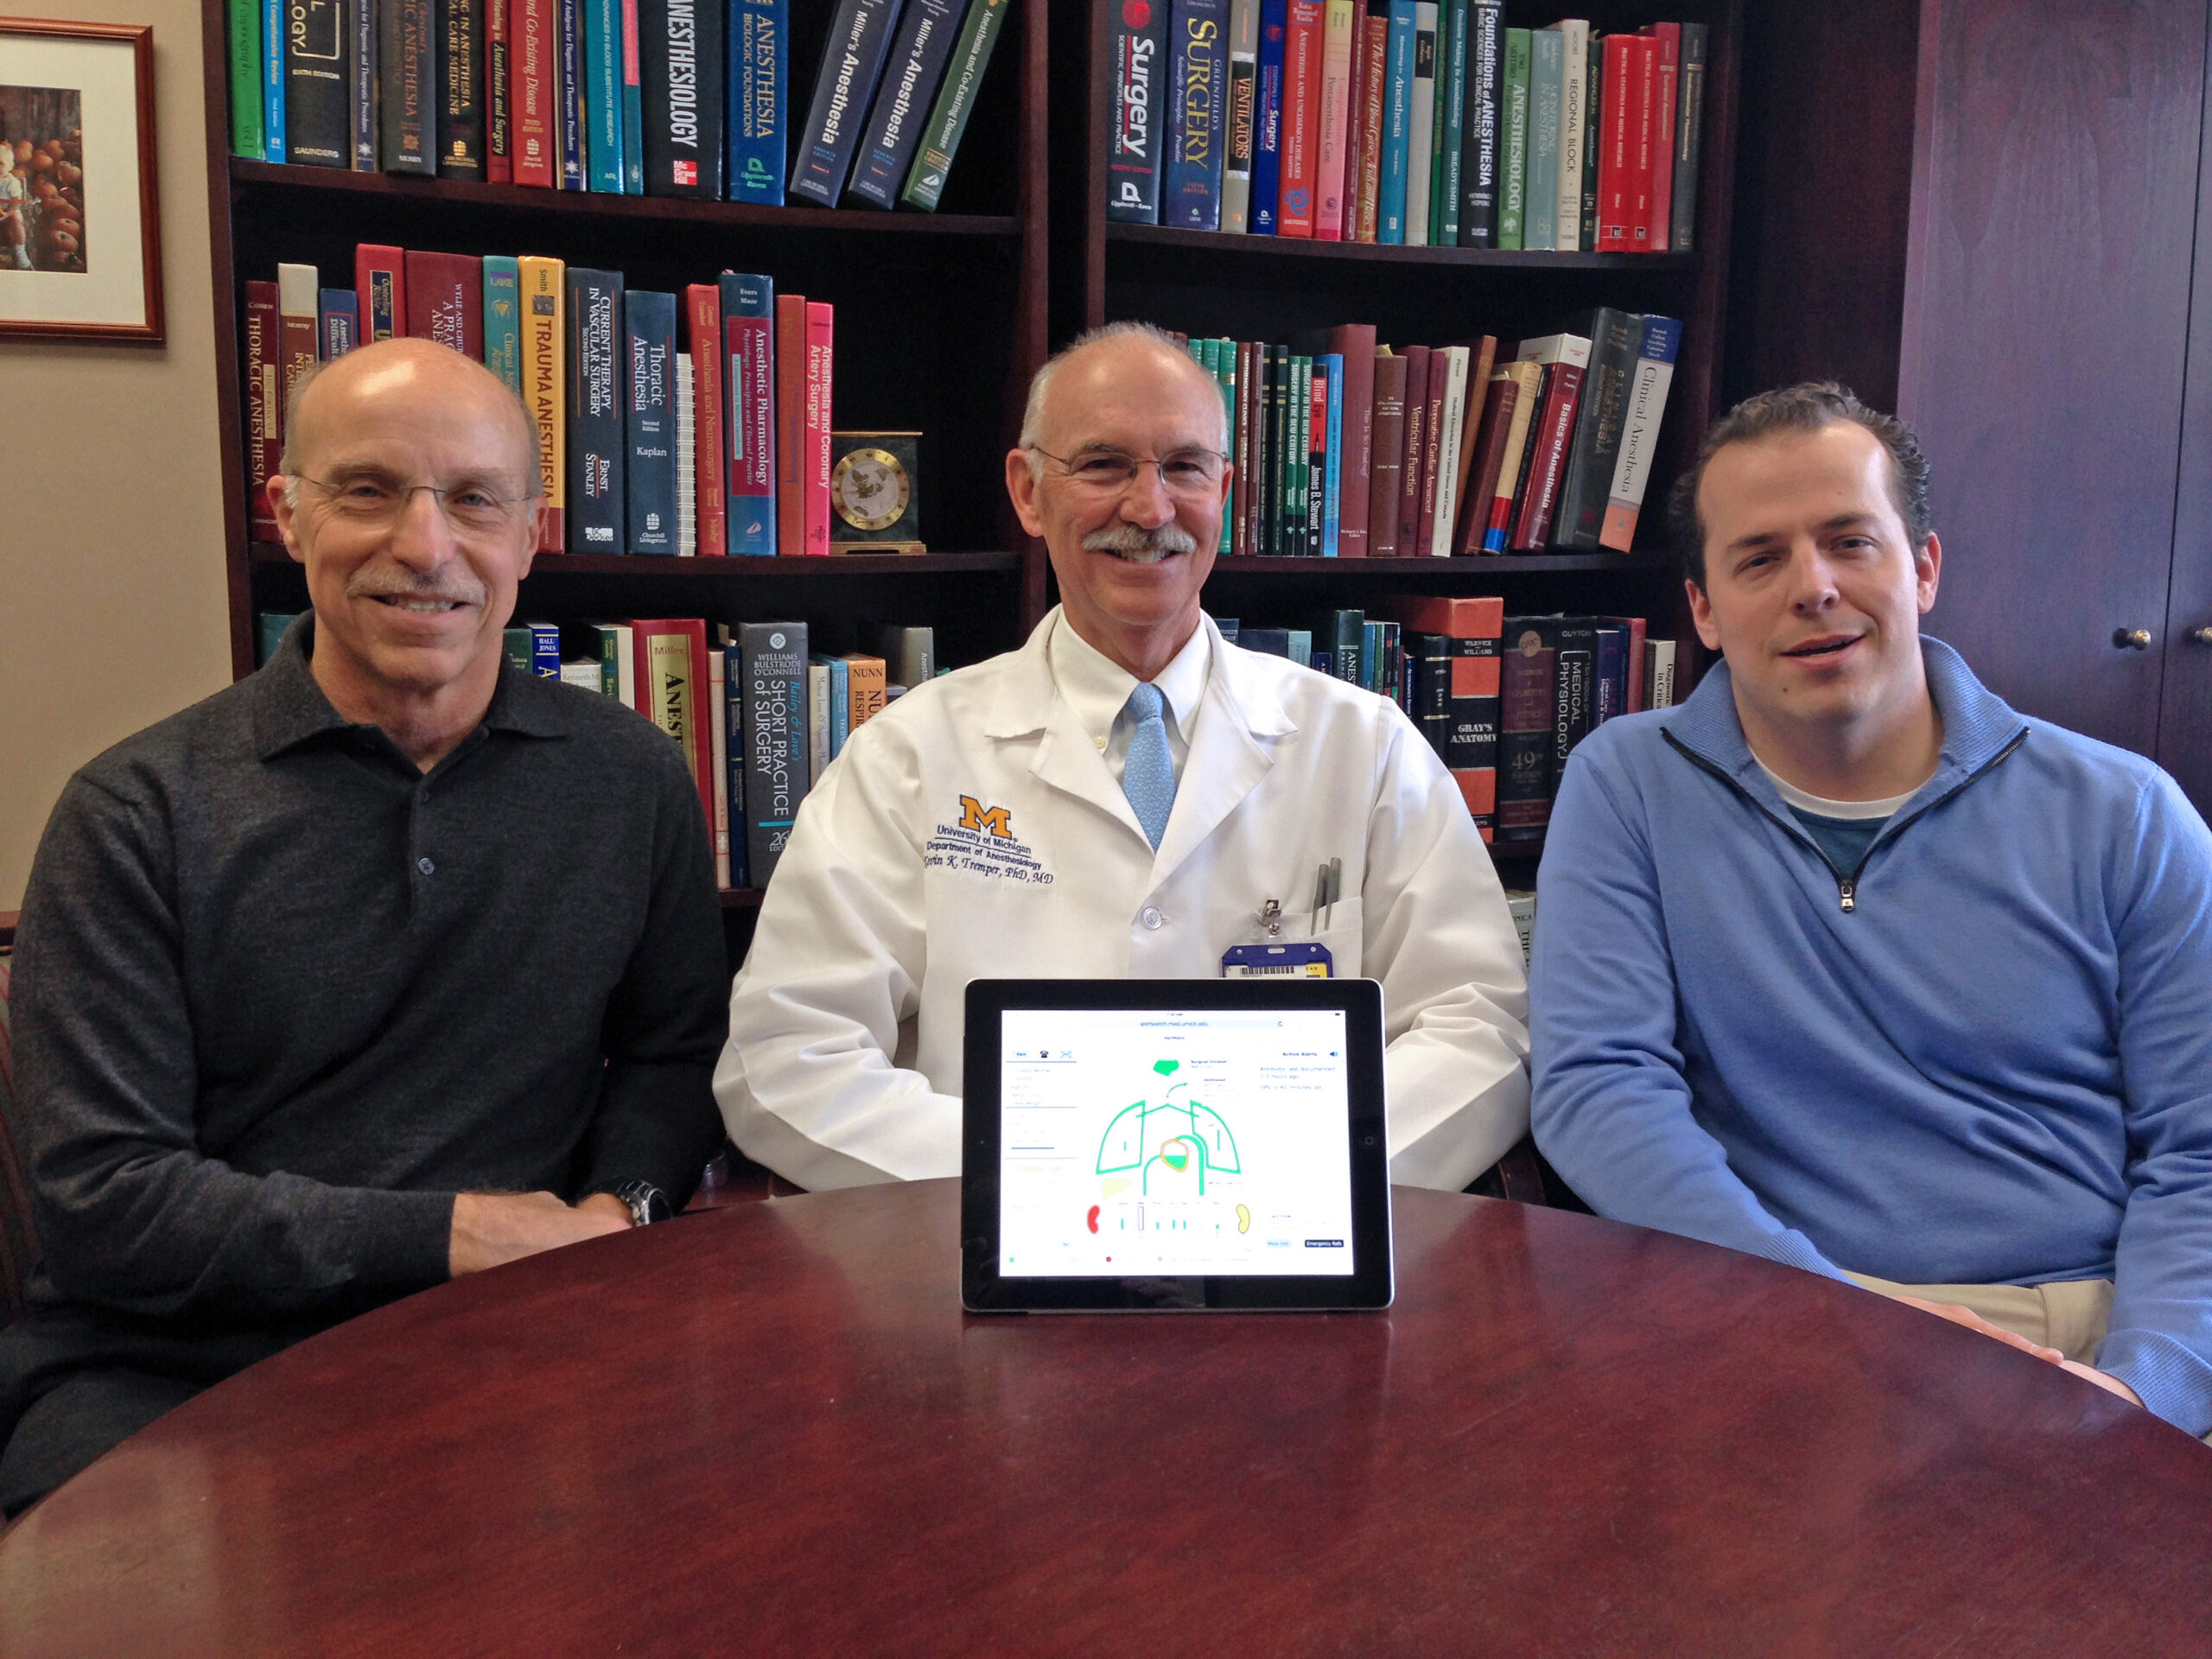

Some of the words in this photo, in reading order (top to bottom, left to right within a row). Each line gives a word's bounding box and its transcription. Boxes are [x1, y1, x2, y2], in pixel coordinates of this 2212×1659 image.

[742, 13, 753, 63] BIOLOGIC
[847, 10, 868, 51] Miller's
[911, 18, 933, 58] Miller's
[970, 9, 995, 54] Anesthesia
[1456, 9, 1465, 39] Decision
[565, 43, 575, 72] Diagnostic
[964, 54, 977, 71] and
[1297, 29, 1310, 79] ANESTHESIA
[1454, 40, 1463, 67] Making
[1476, 29, 1484, 60] SCIENCES
[1483, 8, 1499, 89] Foundations
[270, 60, 278, 86] Review
[493, 43, 505, 96] Anesthesia
[567, 74, 575, 85] and
[756, 14, 775, 138] ANESTHESIA
[1298, 80, 1306, 98] AND
[494, 98, 505, 116] and
[564, 86, 575, 118] Therapeutic
[742, 66, 753, 137] FOUNDATIONS
[821, 52, 860, 144] Anesthesia
[881, 59, 923, 149] Anesthesia
[947, 71, 971, 118] Co-Existing
[1122, 35, 1155, 158] Surgery
[1185, 17, 1218, 171] SURGERY
[1325, 76, 1336, 139] Postanesthesia
[1452, 78, 1461, 129] Anesthesiology
[1474, 77, 1483, 105] CLINICAL
[1483, 90, 1491, 99] of
[1567, 79, 1578, 133] REGIONAL
[493, 118, 505, 155] Surgery
[566, 121, 575, 151] Procedures
[938, 118, 957, 149] Disease
[1235, 77, 1252, 160] VENTILATORS
[1295, 99, 1305, 144] UNCOMMON
[1473, 105, 1482, 139] PRACTICE
[294, 147, 340, 158] SAUNDERS
[1294, 144, 1303, 179] DISEASES
[1324, 142, 1334, 162] Care
[1478, 99, 1495, 187] ANESTHESIA
[1508, 84, 1526, 213] ANESTHESIOLOGY
[1567, 138, 1577, 173] BLOCK
[674, 161, 688, 169] Mc
[1449, 150, 1459, 212] BREADY/SMITH
[538, 269, 550, 292] Smith
[589, 287, 601, 301] IN
[329, 317, 340, 354] Difficult
[589, 302, 601, 363] VASCULAR
[600, 296, 613, 353] CURRENT
[248, 315, 262, 391] THORACIC
[504, 333, 516, 368] Clinical
[536, 319, 553, 392] TRAUMA
[702, 338, 715, 393] Anesthesia
[743, 328, 753, 365] Physiologic
[755, 328, 769, 395] Anesthetic
[810, 345, 821, 382] Artery
[589, 365, 601, 417] SURGERY
[600, 355, 613, 410] THERAPY
[633, 334, 650, 411] Anesthesia
[651, 344, 666, 406] Thoracic
[743, 368, 753, 408] Principles
[821, 345, 832, 406] Anesthesia
[1313, 380, 1325, 402] Blind
[1634, 365, 1659, 420] Clinical
[703, 394, 715, 413] and
[808, 383, 821, 429] Surgery
[821, 406, 831, 427] and
[1312, 404, 1324, 419] Eye
[1428, 398, 1442, 442] Preoperative
[1555, 403, 1571, 438] Basics
[250, 395, 265, 486] ANESTHESIA
[537, 396, 555, 499] ANESTHESIA
[702, 416, 717, 481] Neurosurgery
[755, 397, 769, 486] Pharmacology
[1408, 405, 1423, 454] Ventricular
[1553, 440, 1565, 450] of
[636, 446, 667, 456] Kaplan
[746, 455, 754, 486] Practice
[818, 429, 831, 488] Coronary
[1426, 442, 1439, 474] Cardiac
[1621, 423, 1646, 493] Anesthesia
[585, 453, 597, 497] STANLEY
[599, 459, 611, 491] ERNST
[1310, 465, 1322, 490] James
[1311, 491, 1321, 499] B.
[1405, 457, 1419, 497] Function
[1424, 474, 1436, 513] Assessment
[1541, 451, 1562, 509] Anesthesia
[1310, 499, 1321, 530] Stewart
[654, 646, 684, 656] Miller
[753, 680, 771, 696] of
[853, 667, 884, 678] NUNN
[1656, 672, 1664, 681] in
[1665, 664, 1674, 705] Diagnostic
[664, 672, 686, 746] ANEST
[770, 680, 787, 734] SHORT
[787, 680, 801, 713] Bailey
[855, 690, 866, 729] RESPIR
[1557, 662, 1570, 752] PHYSIOLOGY
[1571, 662, 1582, 725] MEDICAL
[755, 701, 773, 774] SURGERY
[791, 716, 802, 728] &
[1450, 733, 1497, 744] ANATOMY
[1457, 723, 1494, 733] GRAY'S
[791, 730, 803, 762] Love's
[772, 740, 790, 817] PRACTICE
[959, 794, 1013, 841] M
[926, 841, 971, 854] Department
[974, 847, 983, 856] of
[986, 851, 1042, 870] Anesthesiology
[937, 824, 982, 843] University
[982, 836, 992, 846] of
[994, 838, 1032, 854] Michigan
[947, 855, 958, 869] K.
[962, 856, 1002, 878] Tremper,
[1005, 868, 1030, 883] PhD,
[1033, 872, 1054, 884] MD
